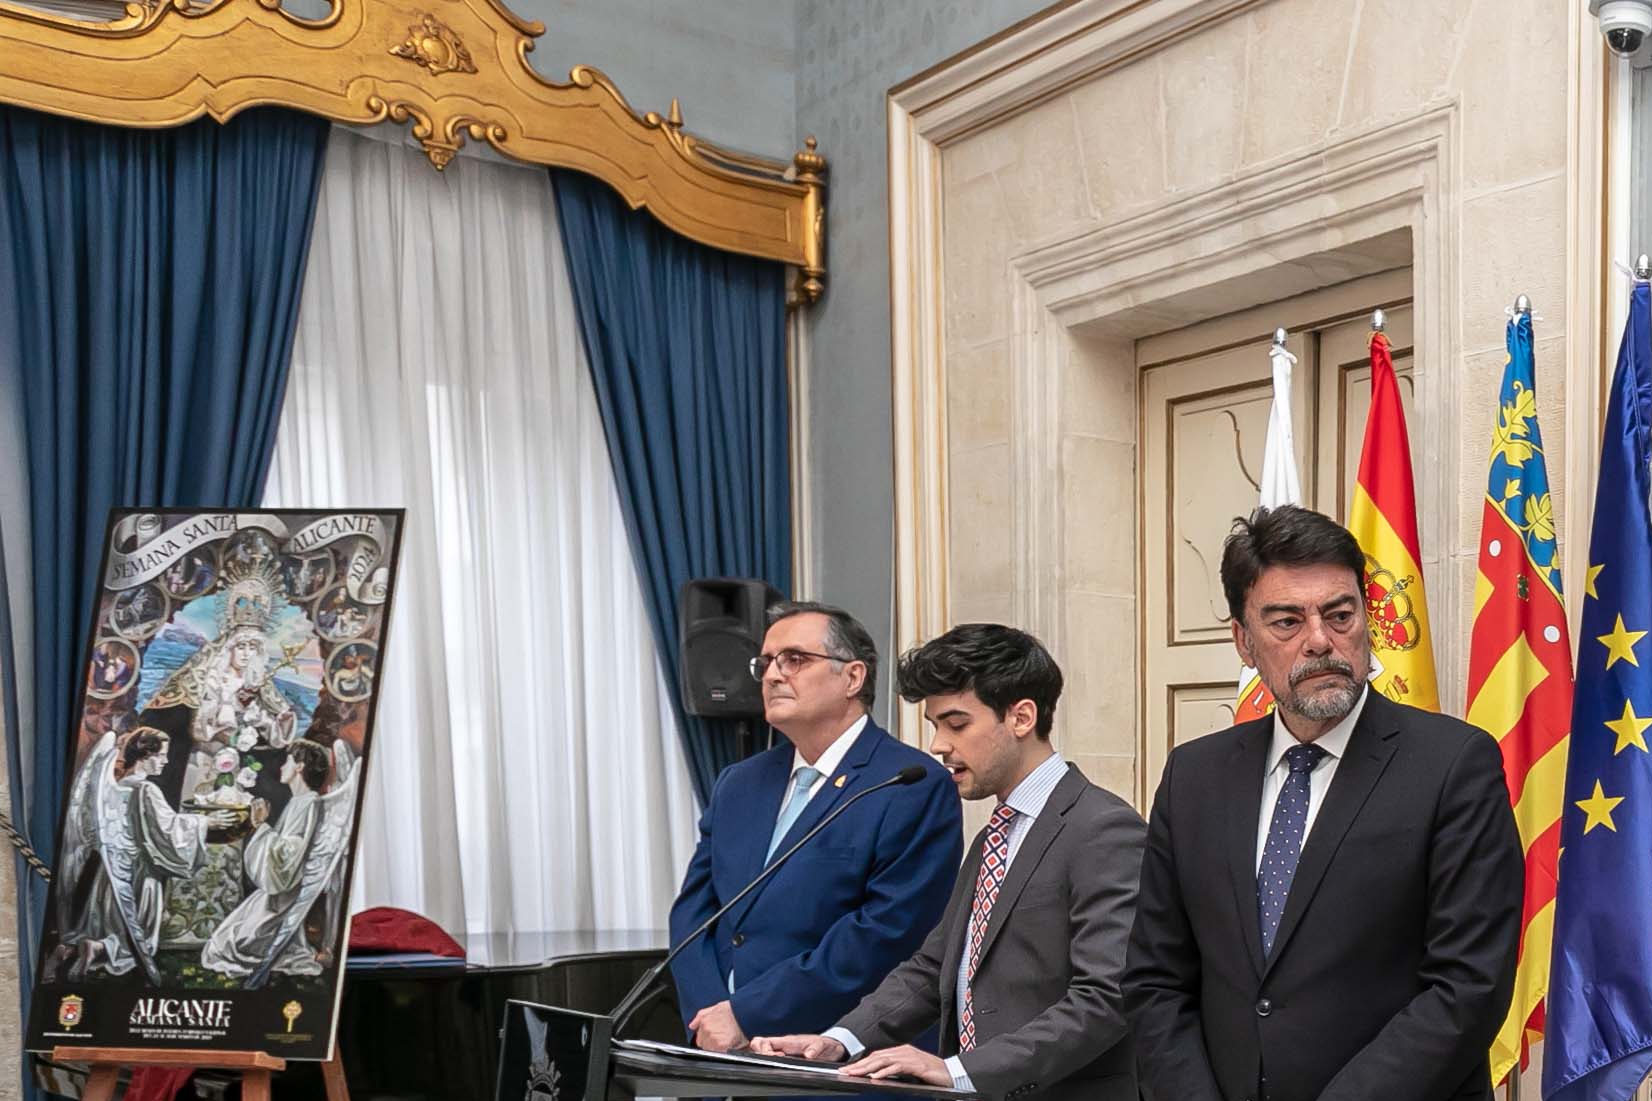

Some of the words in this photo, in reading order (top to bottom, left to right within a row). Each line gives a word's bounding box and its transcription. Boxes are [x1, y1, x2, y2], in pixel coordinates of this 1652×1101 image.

[112, 540, 181, 580] SEMANA
[183, 515, 238, 546] SANTA
[294, 515, 376, 552] ALICANTE
[351, 546, 376, 582] 2024
[131, 998, 232, 1020] ALICANTE
